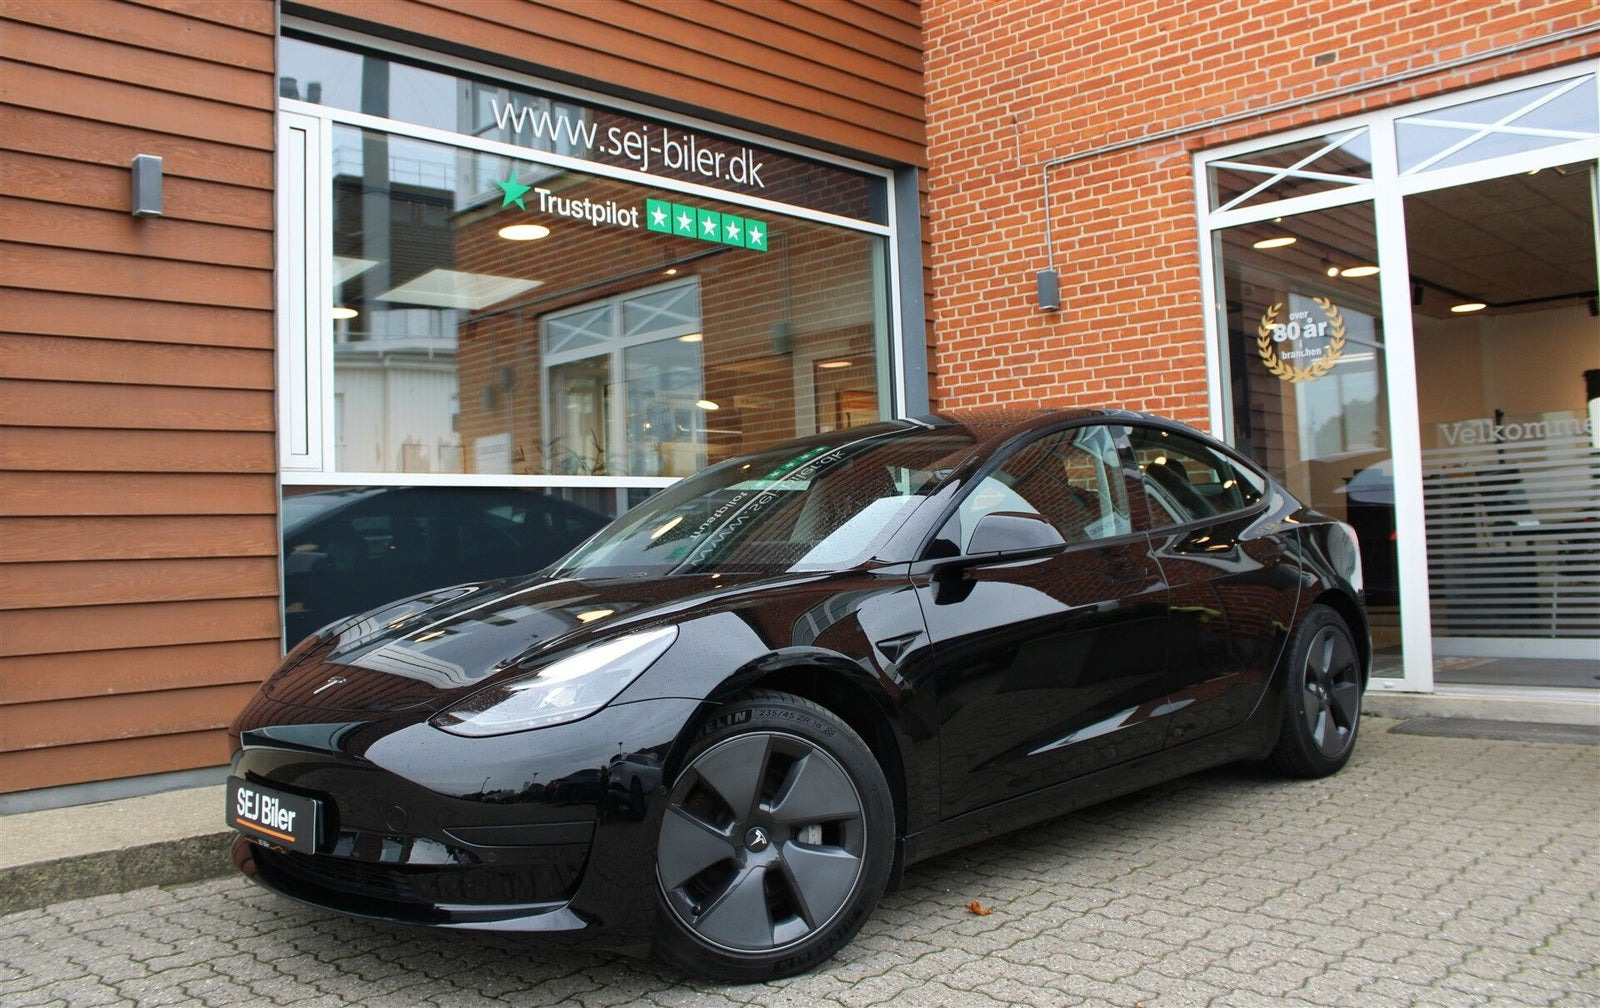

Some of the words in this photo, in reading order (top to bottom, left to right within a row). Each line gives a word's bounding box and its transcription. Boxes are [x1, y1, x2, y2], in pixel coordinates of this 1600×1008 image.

[491, 99, 766, 188] www.sej-biler.dk
[534, 187, 639, 228] Trustpilot
[1289, 311, 1308, 320] over
[1273, 321, 1300, 342] 80
[1303, 317, 1327, 338] år
[1281, 348, 1322, 359] branchen
[759, 709, 795, 719] 235/45
[237, 787, 259, 820] SEJ
[261, 795, 296, 832] Biler
